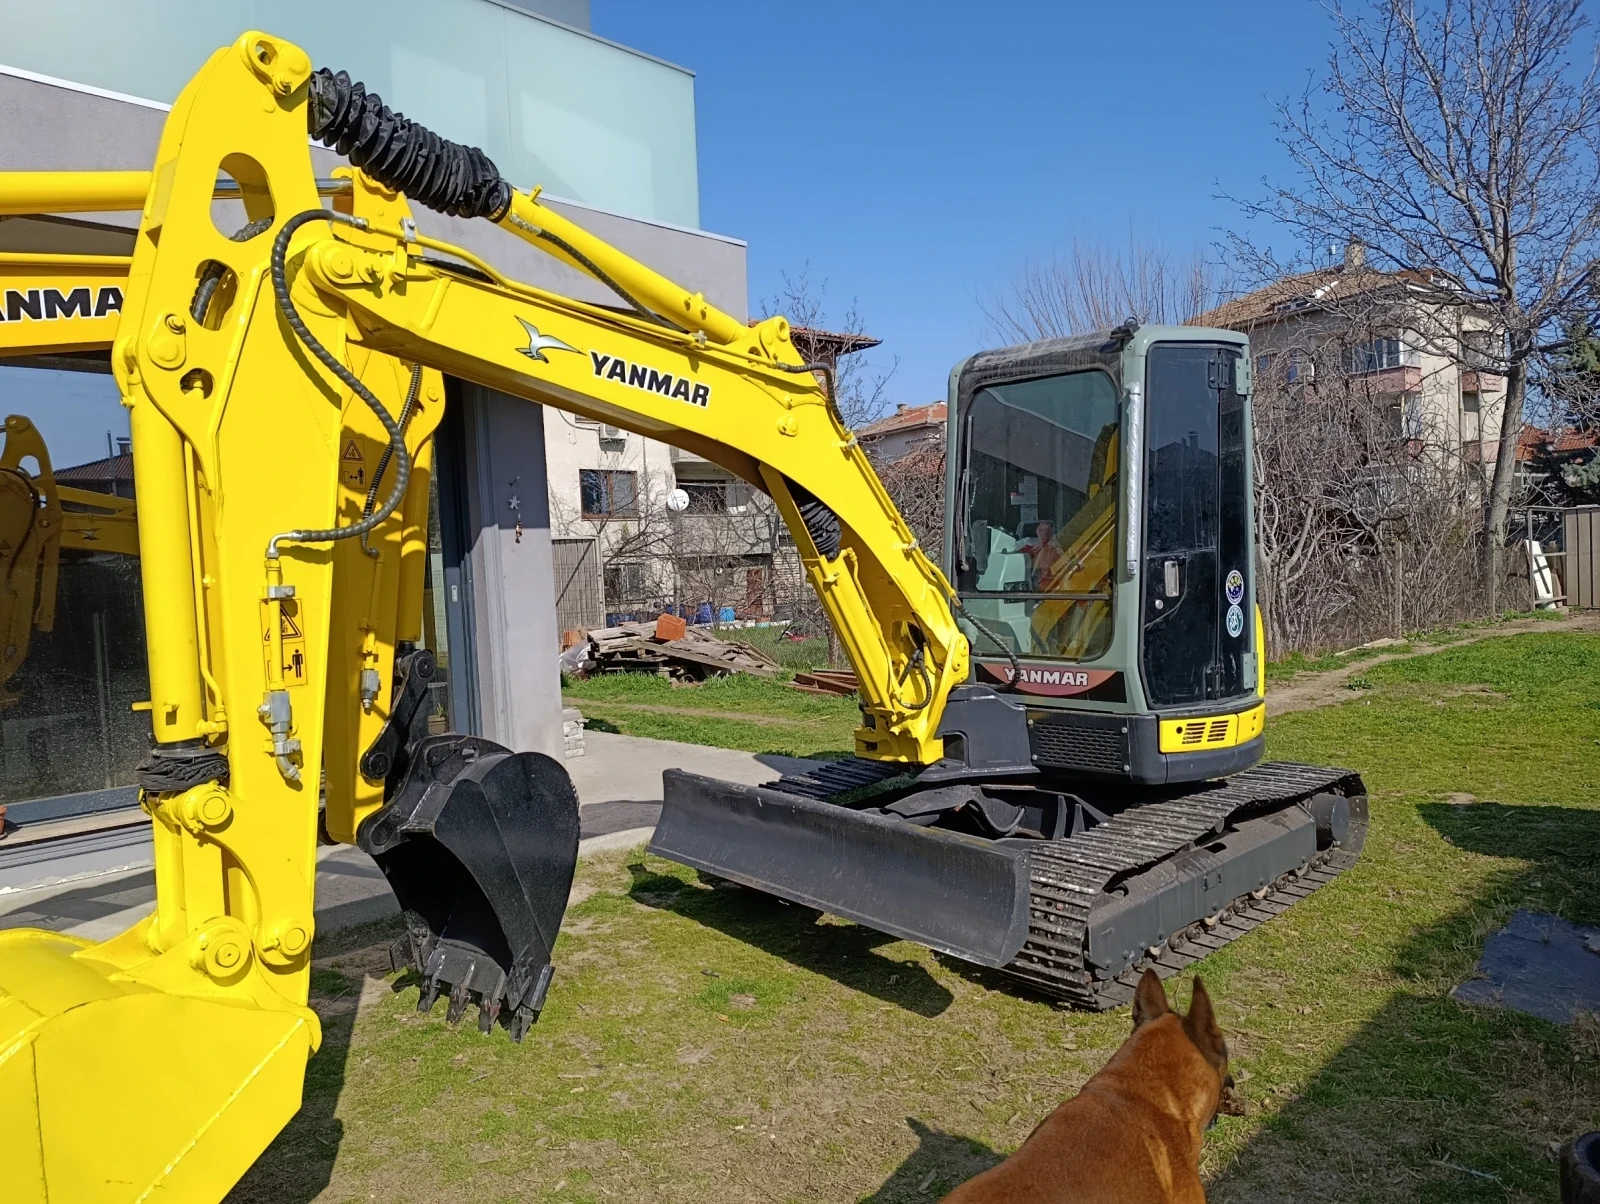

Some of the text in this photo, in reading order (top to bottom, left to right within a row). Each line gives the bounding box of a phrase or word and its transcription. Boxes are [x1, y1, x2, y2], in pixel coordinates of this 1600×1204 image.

[0, 287, 124, 321] NMA
[590, 350, 710, 408] YANMAR
[1003, 667, 1089, 687] YANMAR
